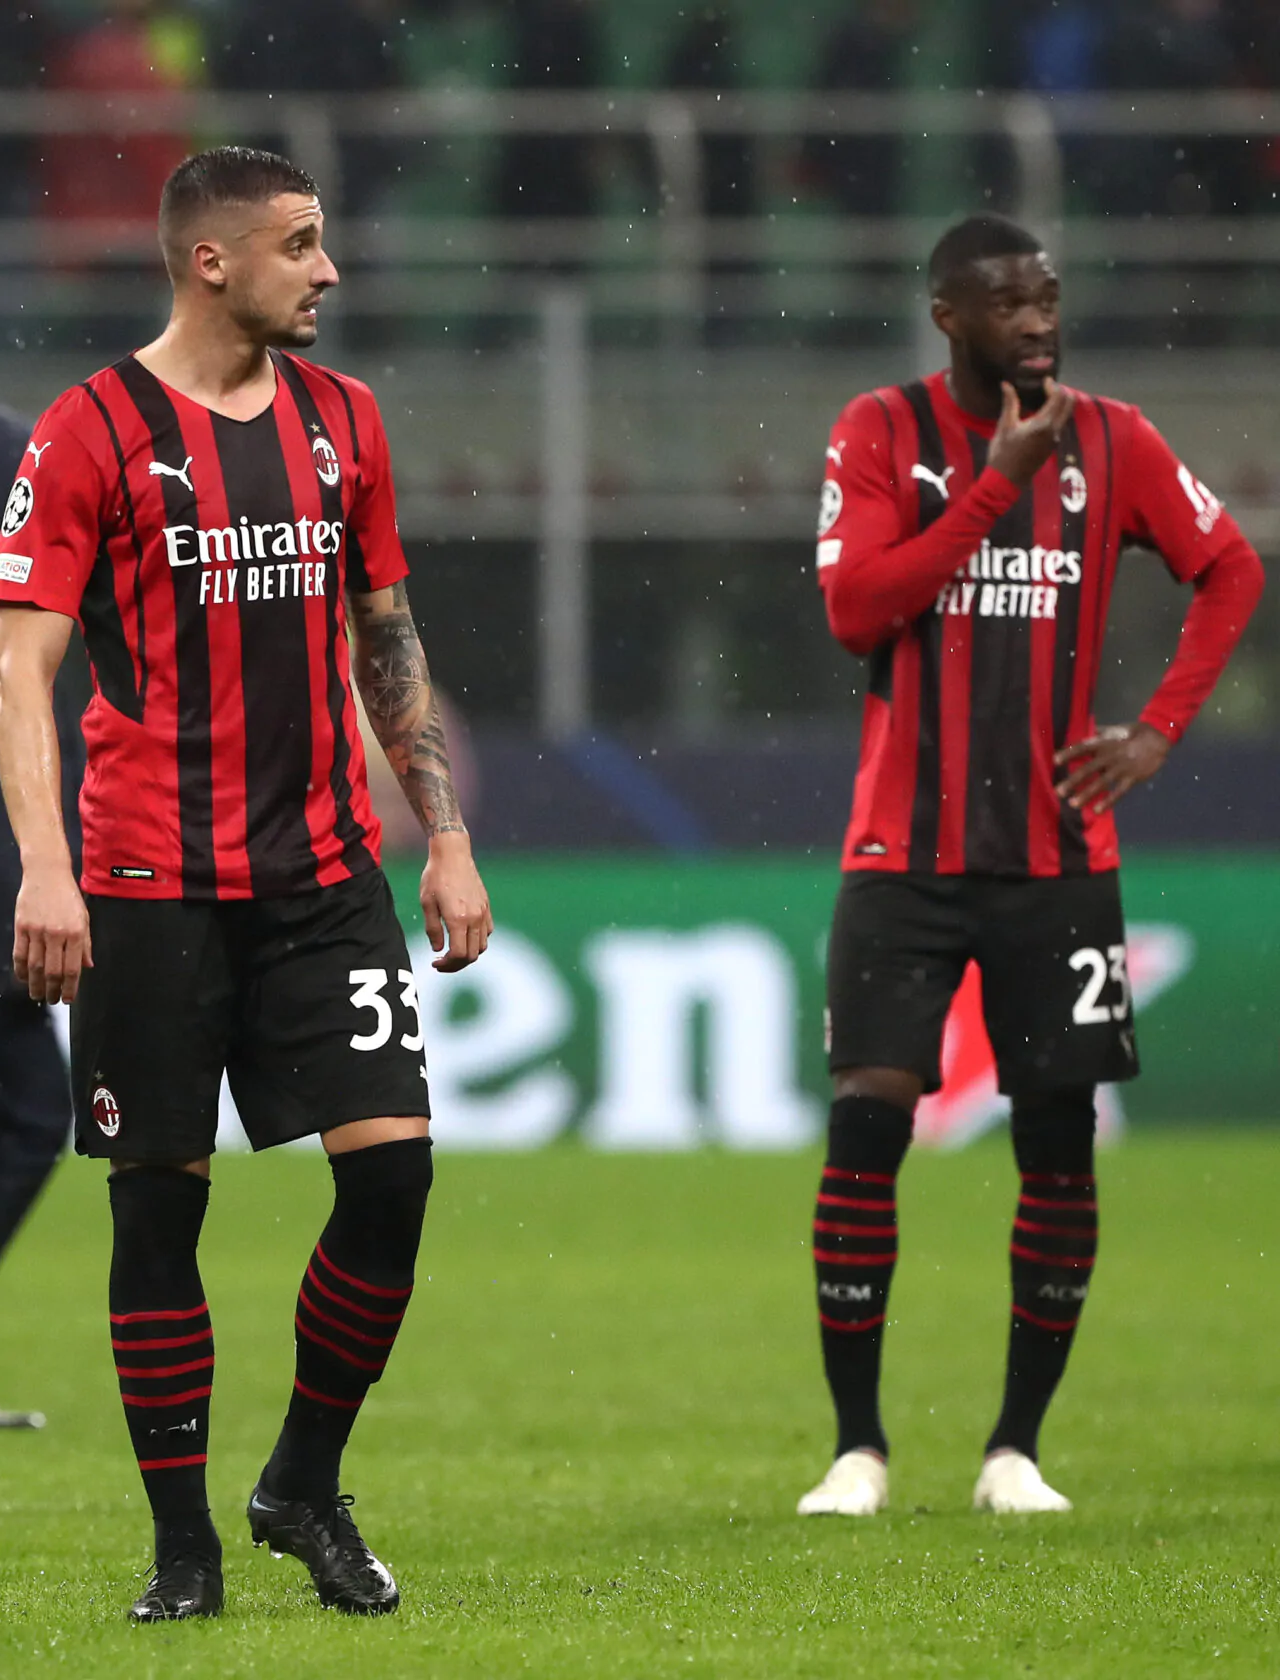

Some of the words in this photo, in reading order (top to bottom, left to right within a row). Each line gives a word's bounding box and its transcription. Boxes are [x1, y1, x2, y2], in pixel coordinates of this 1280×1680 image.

[162, 515, 343, 568] Emirates
[956, 537, 1082, 584] irates
[199, 568, 239, 606] FLY
[246, 562, 326, 601] BETTER
[935, 582, 977, 616] FLY
[978, 583, 1058, 620] BETTER
[1068, 944, 1132, 1025] 23
[349, 968, 424, 1052] 33
[820, 1281, 872, 1301] ACM
